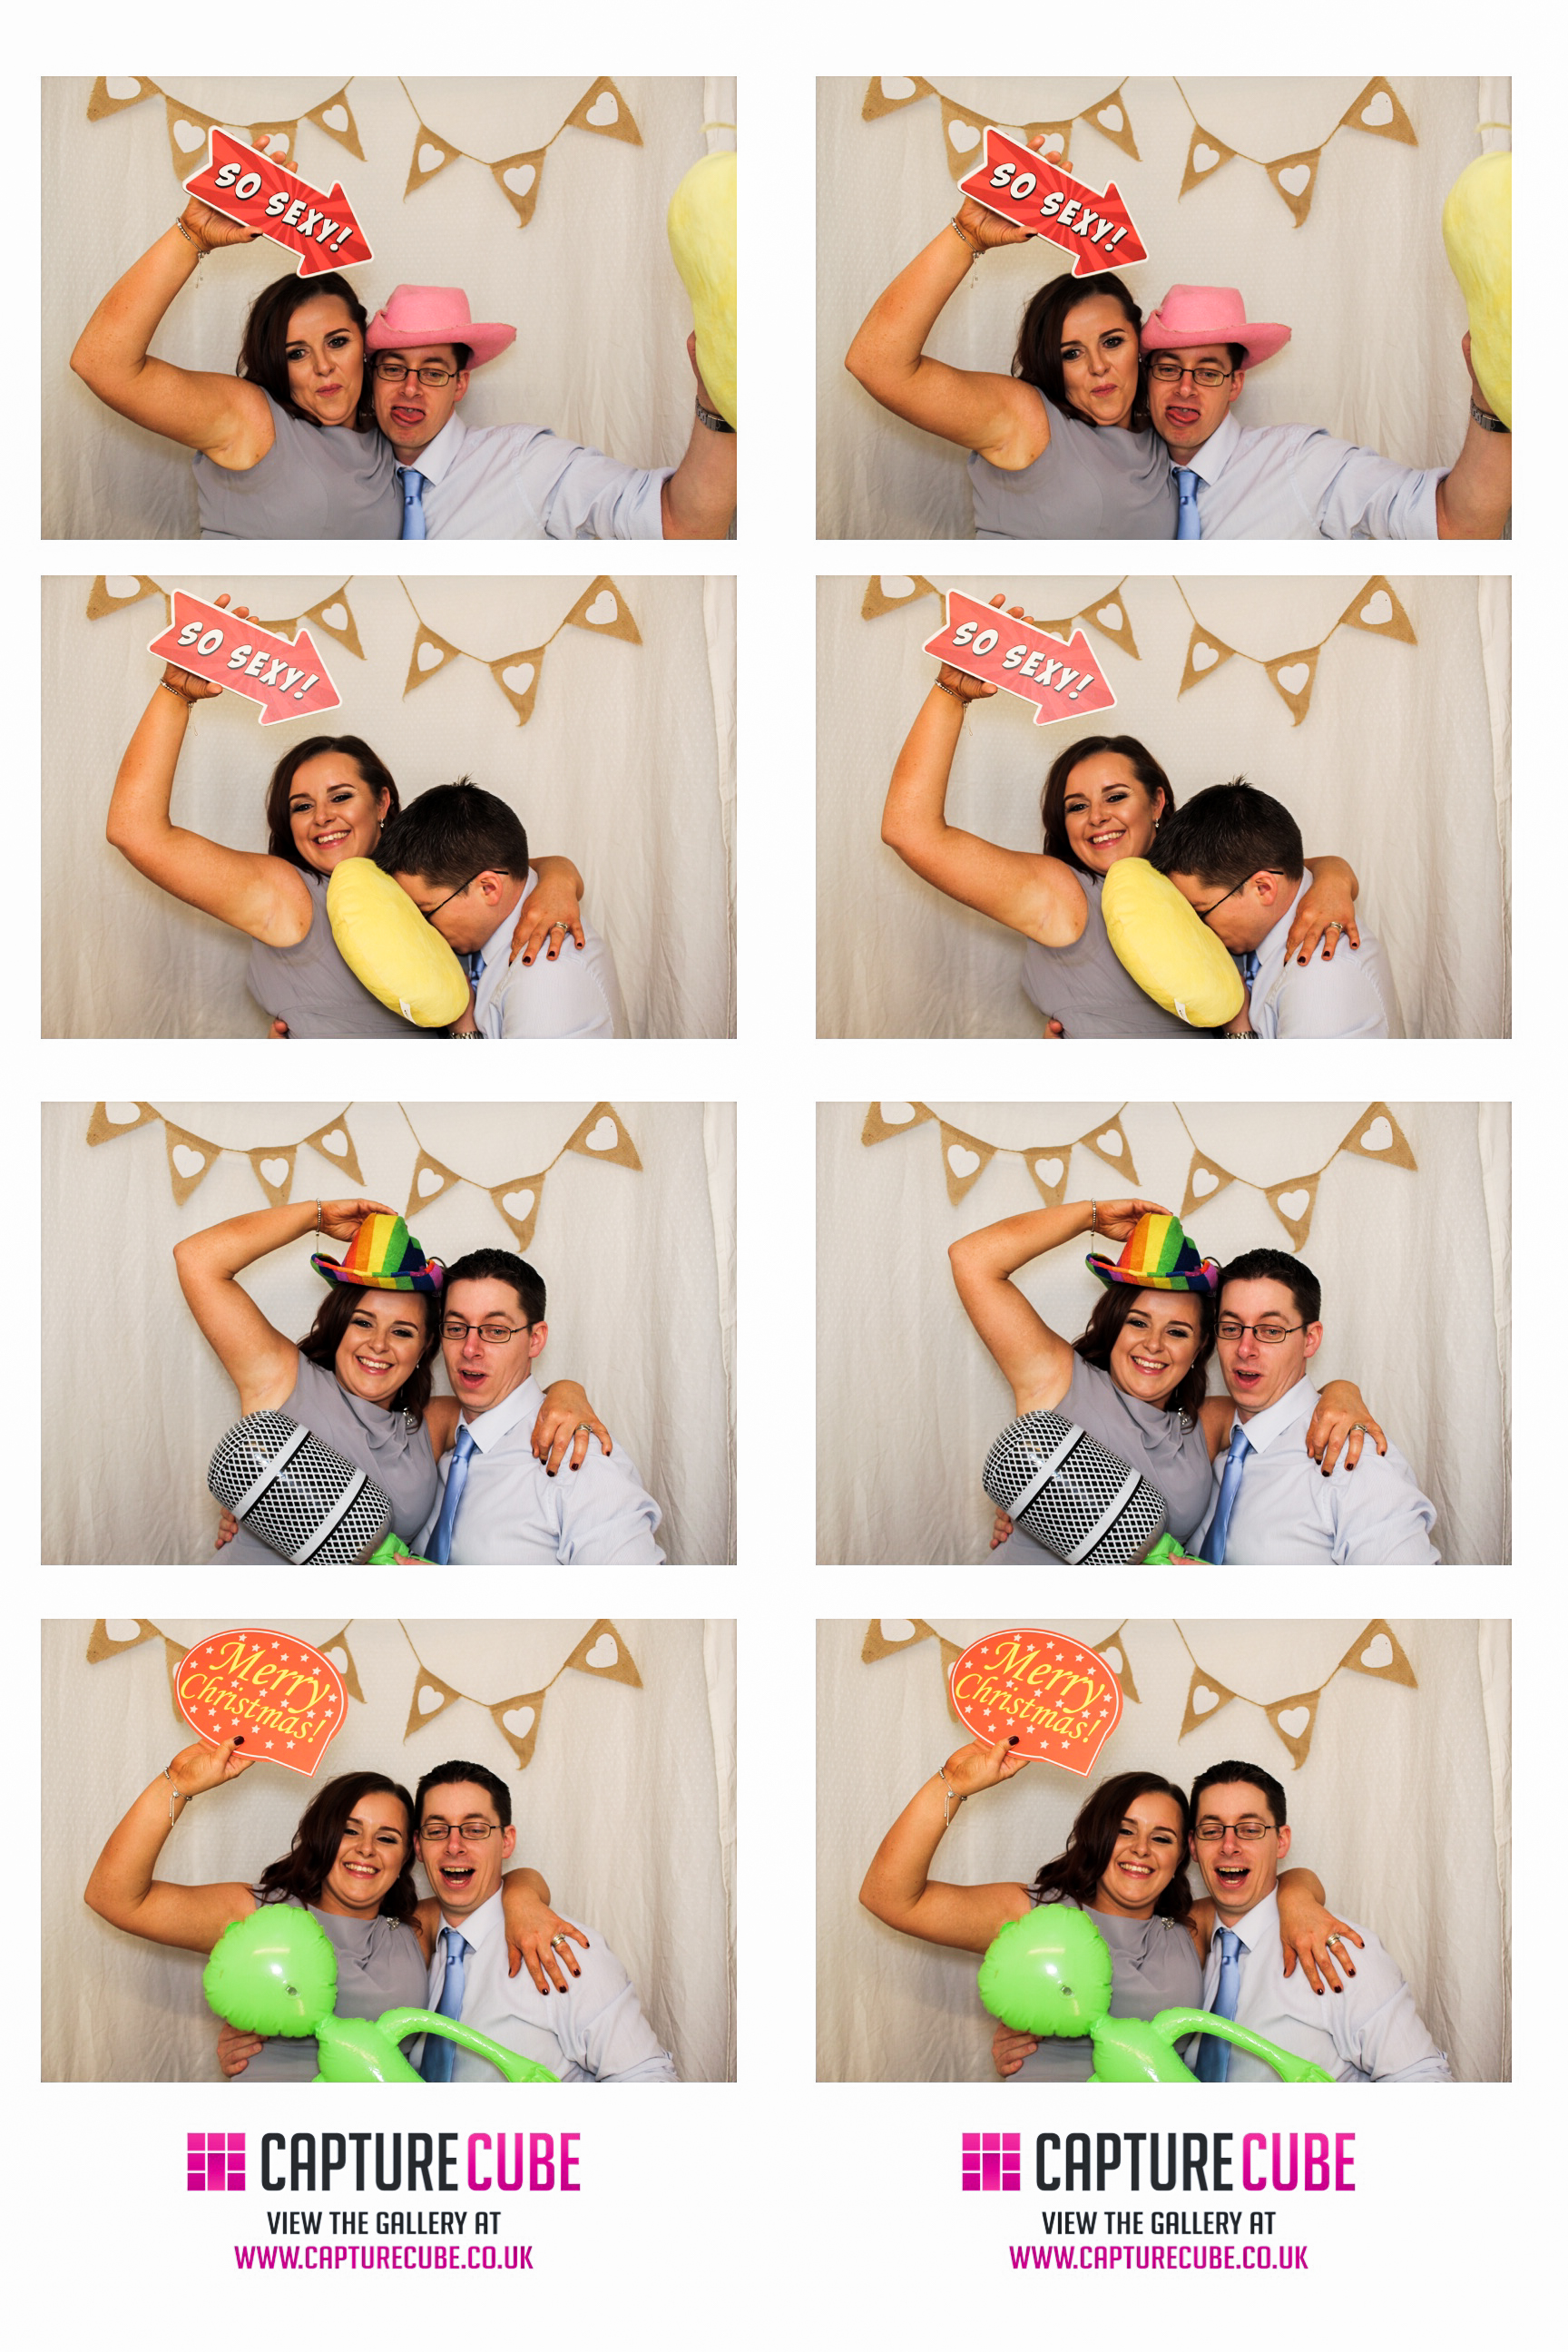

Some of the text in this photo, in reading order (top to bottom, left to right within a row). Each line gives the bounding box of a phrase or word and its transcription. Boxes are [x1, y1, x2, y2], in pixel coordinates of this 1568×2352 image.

[214, 162, 354, 253] SO SEXY!
[989, 162, 1129, 253] SO SEXY!
[177, 621, 320, 701] SO SEXY!
[952, 621, 1095, 701] SO SEXY!
[180, 1642, 331, 1744] Merry Christmas!
[955, 1642, 1106, 1744] Merry Christmas!
